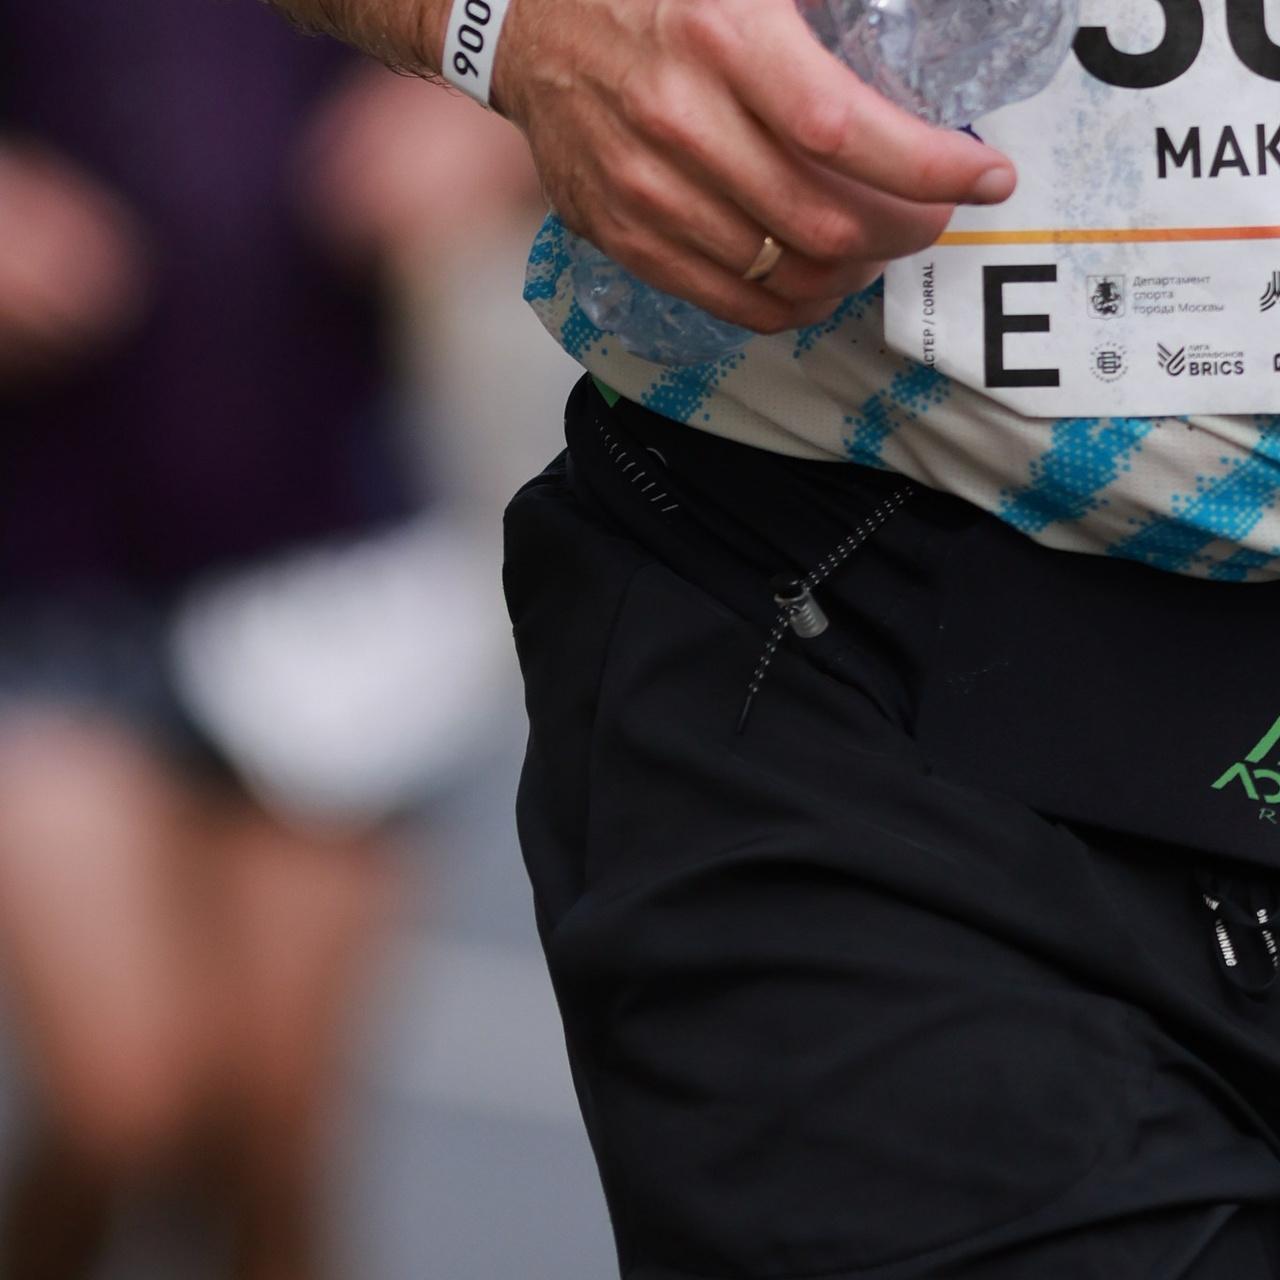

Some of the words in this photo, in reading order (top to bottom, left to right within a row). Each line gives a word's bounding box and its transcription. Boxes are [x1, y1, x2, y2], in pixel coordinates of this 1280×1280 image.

[1133, 275, 1211, 287] Департамент
[922, 262, 935, 317] CORRAL
[1133, 291, 1175, 301] спорта
[1133, 304, 1175, 316] города
[1178, 302, 1225, 313] Москвы
[1188, 360, 1245, 376] BRICS
